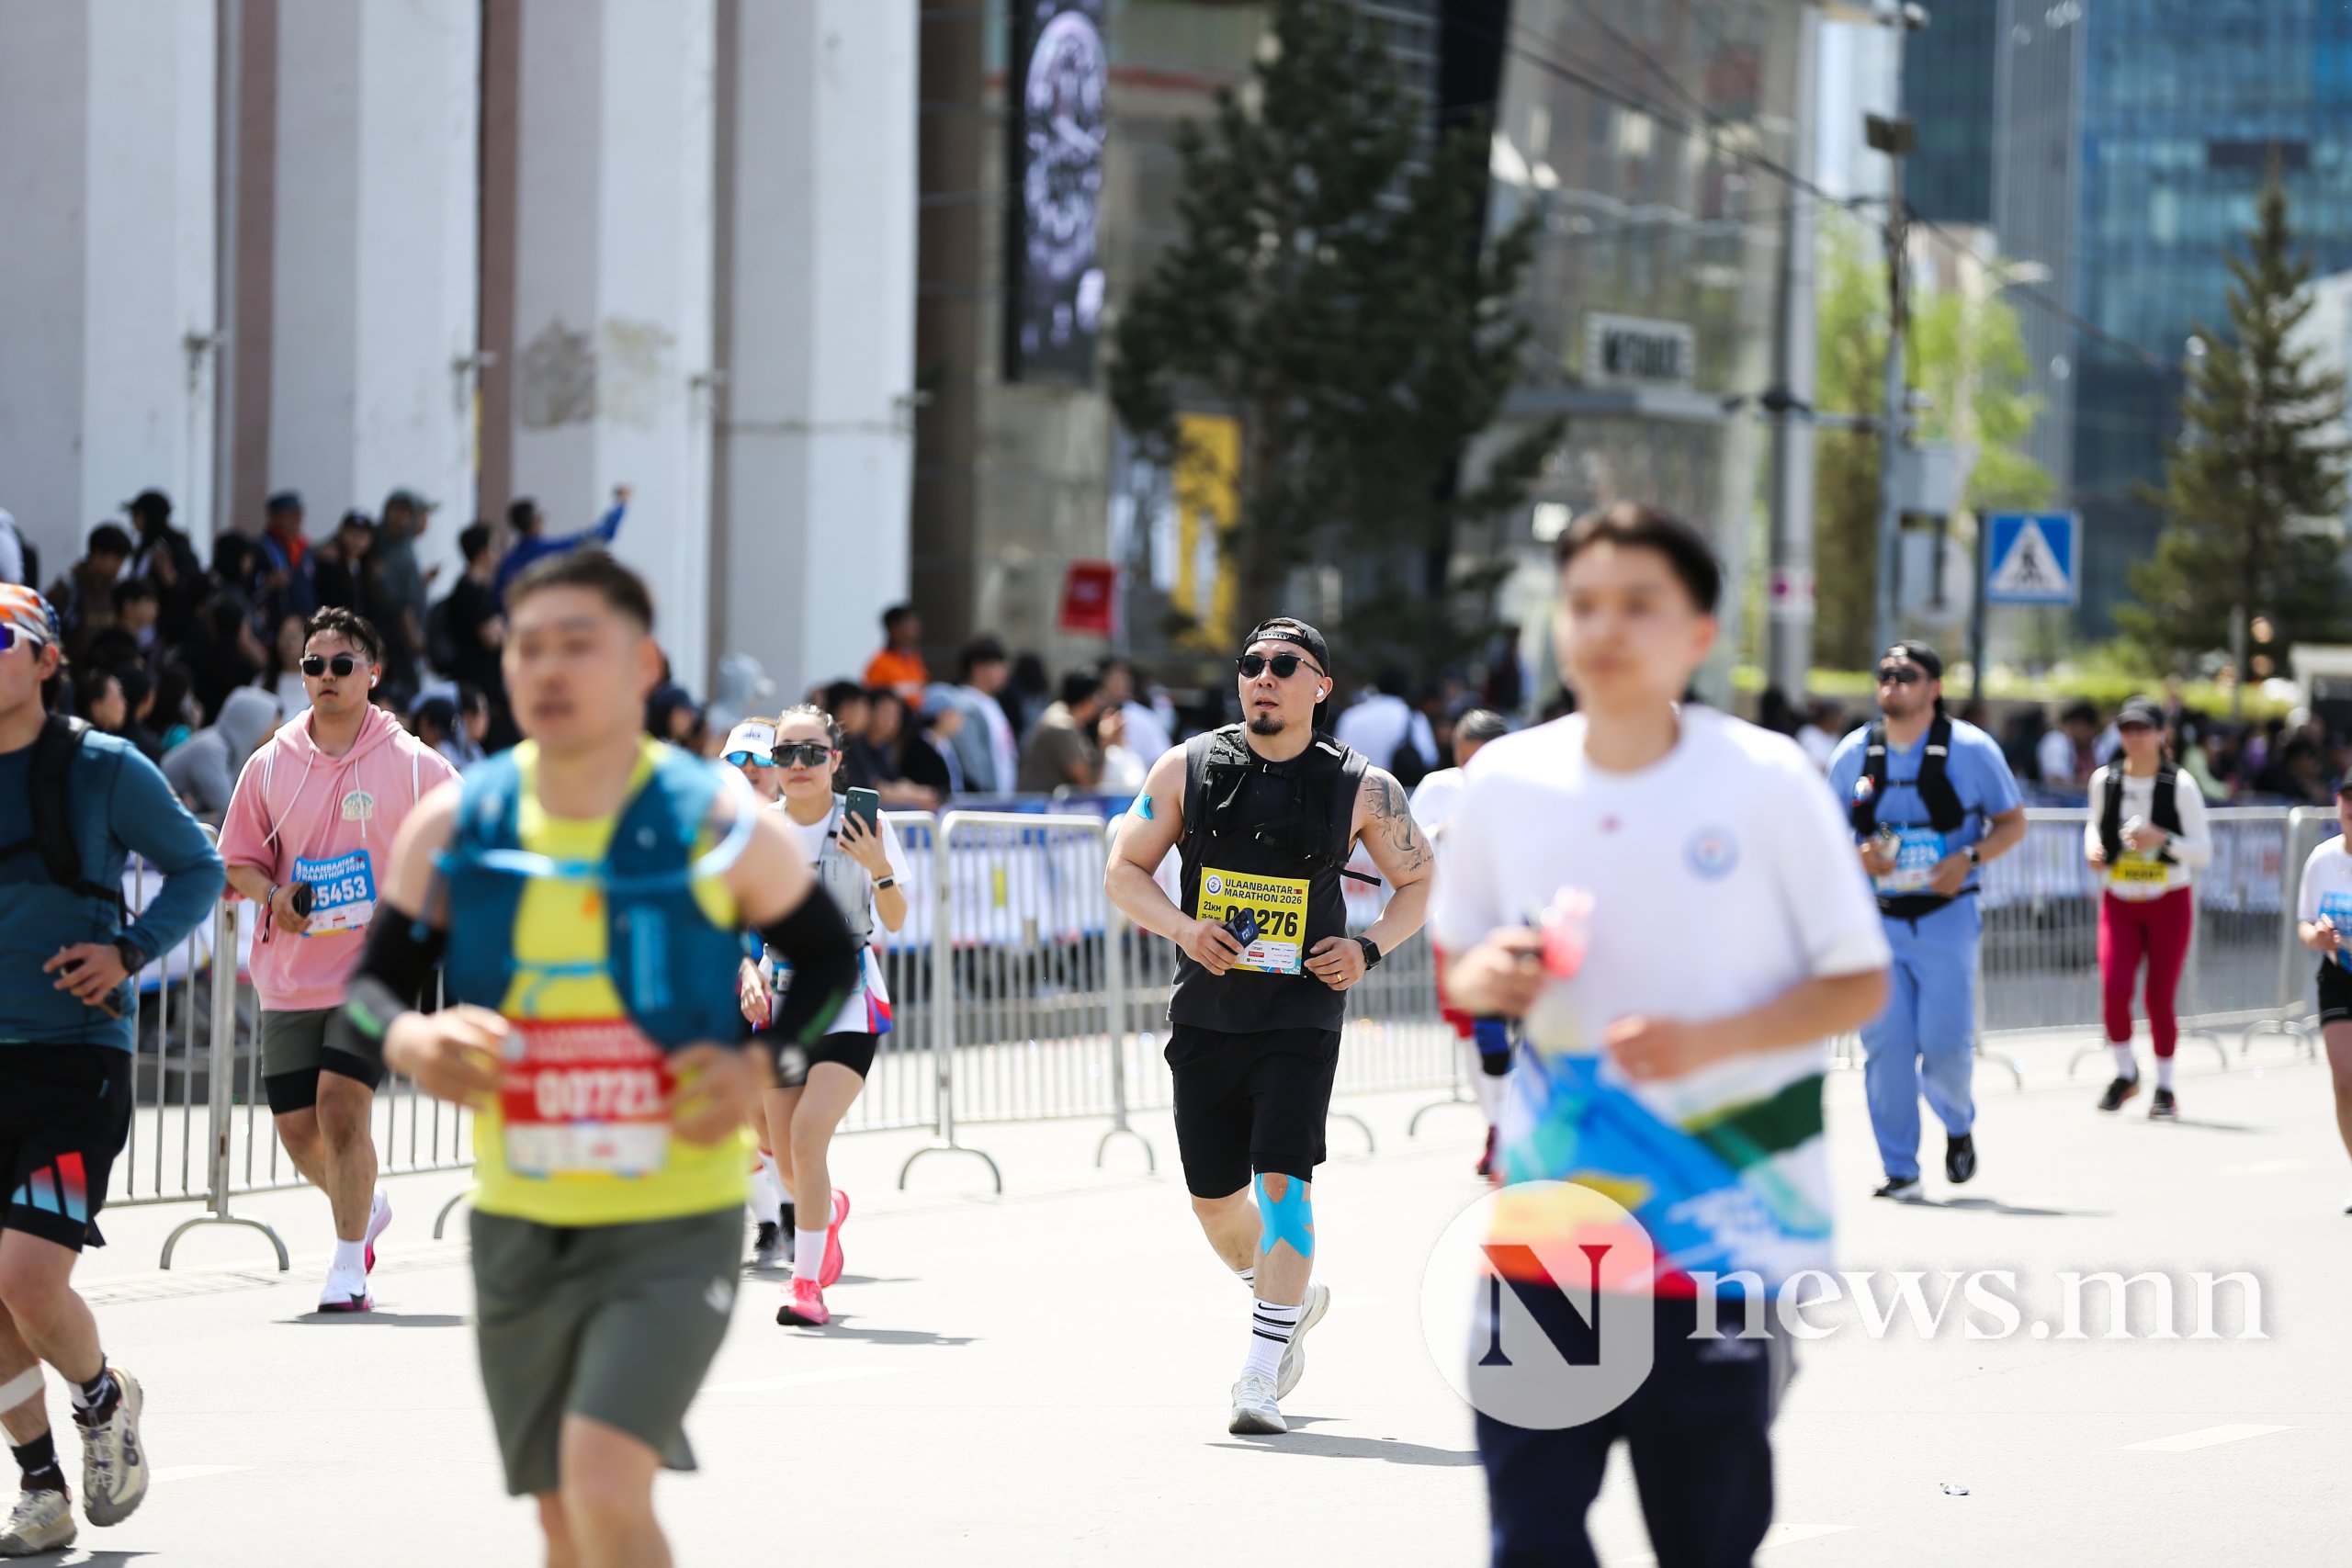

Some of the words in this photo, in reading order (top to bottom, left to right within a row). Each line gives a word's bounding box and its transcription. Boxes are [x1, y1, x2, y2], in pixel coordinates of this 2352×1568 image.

[311, 875, 368, 908] 5453
[1224, 888, 1278, 903] MARATHON
[1280, 895, 1303, 905] 2026
[1225, 878, 1294, 895] ULAANBAATAR
[1225, 905, 1298, 937] 0276
